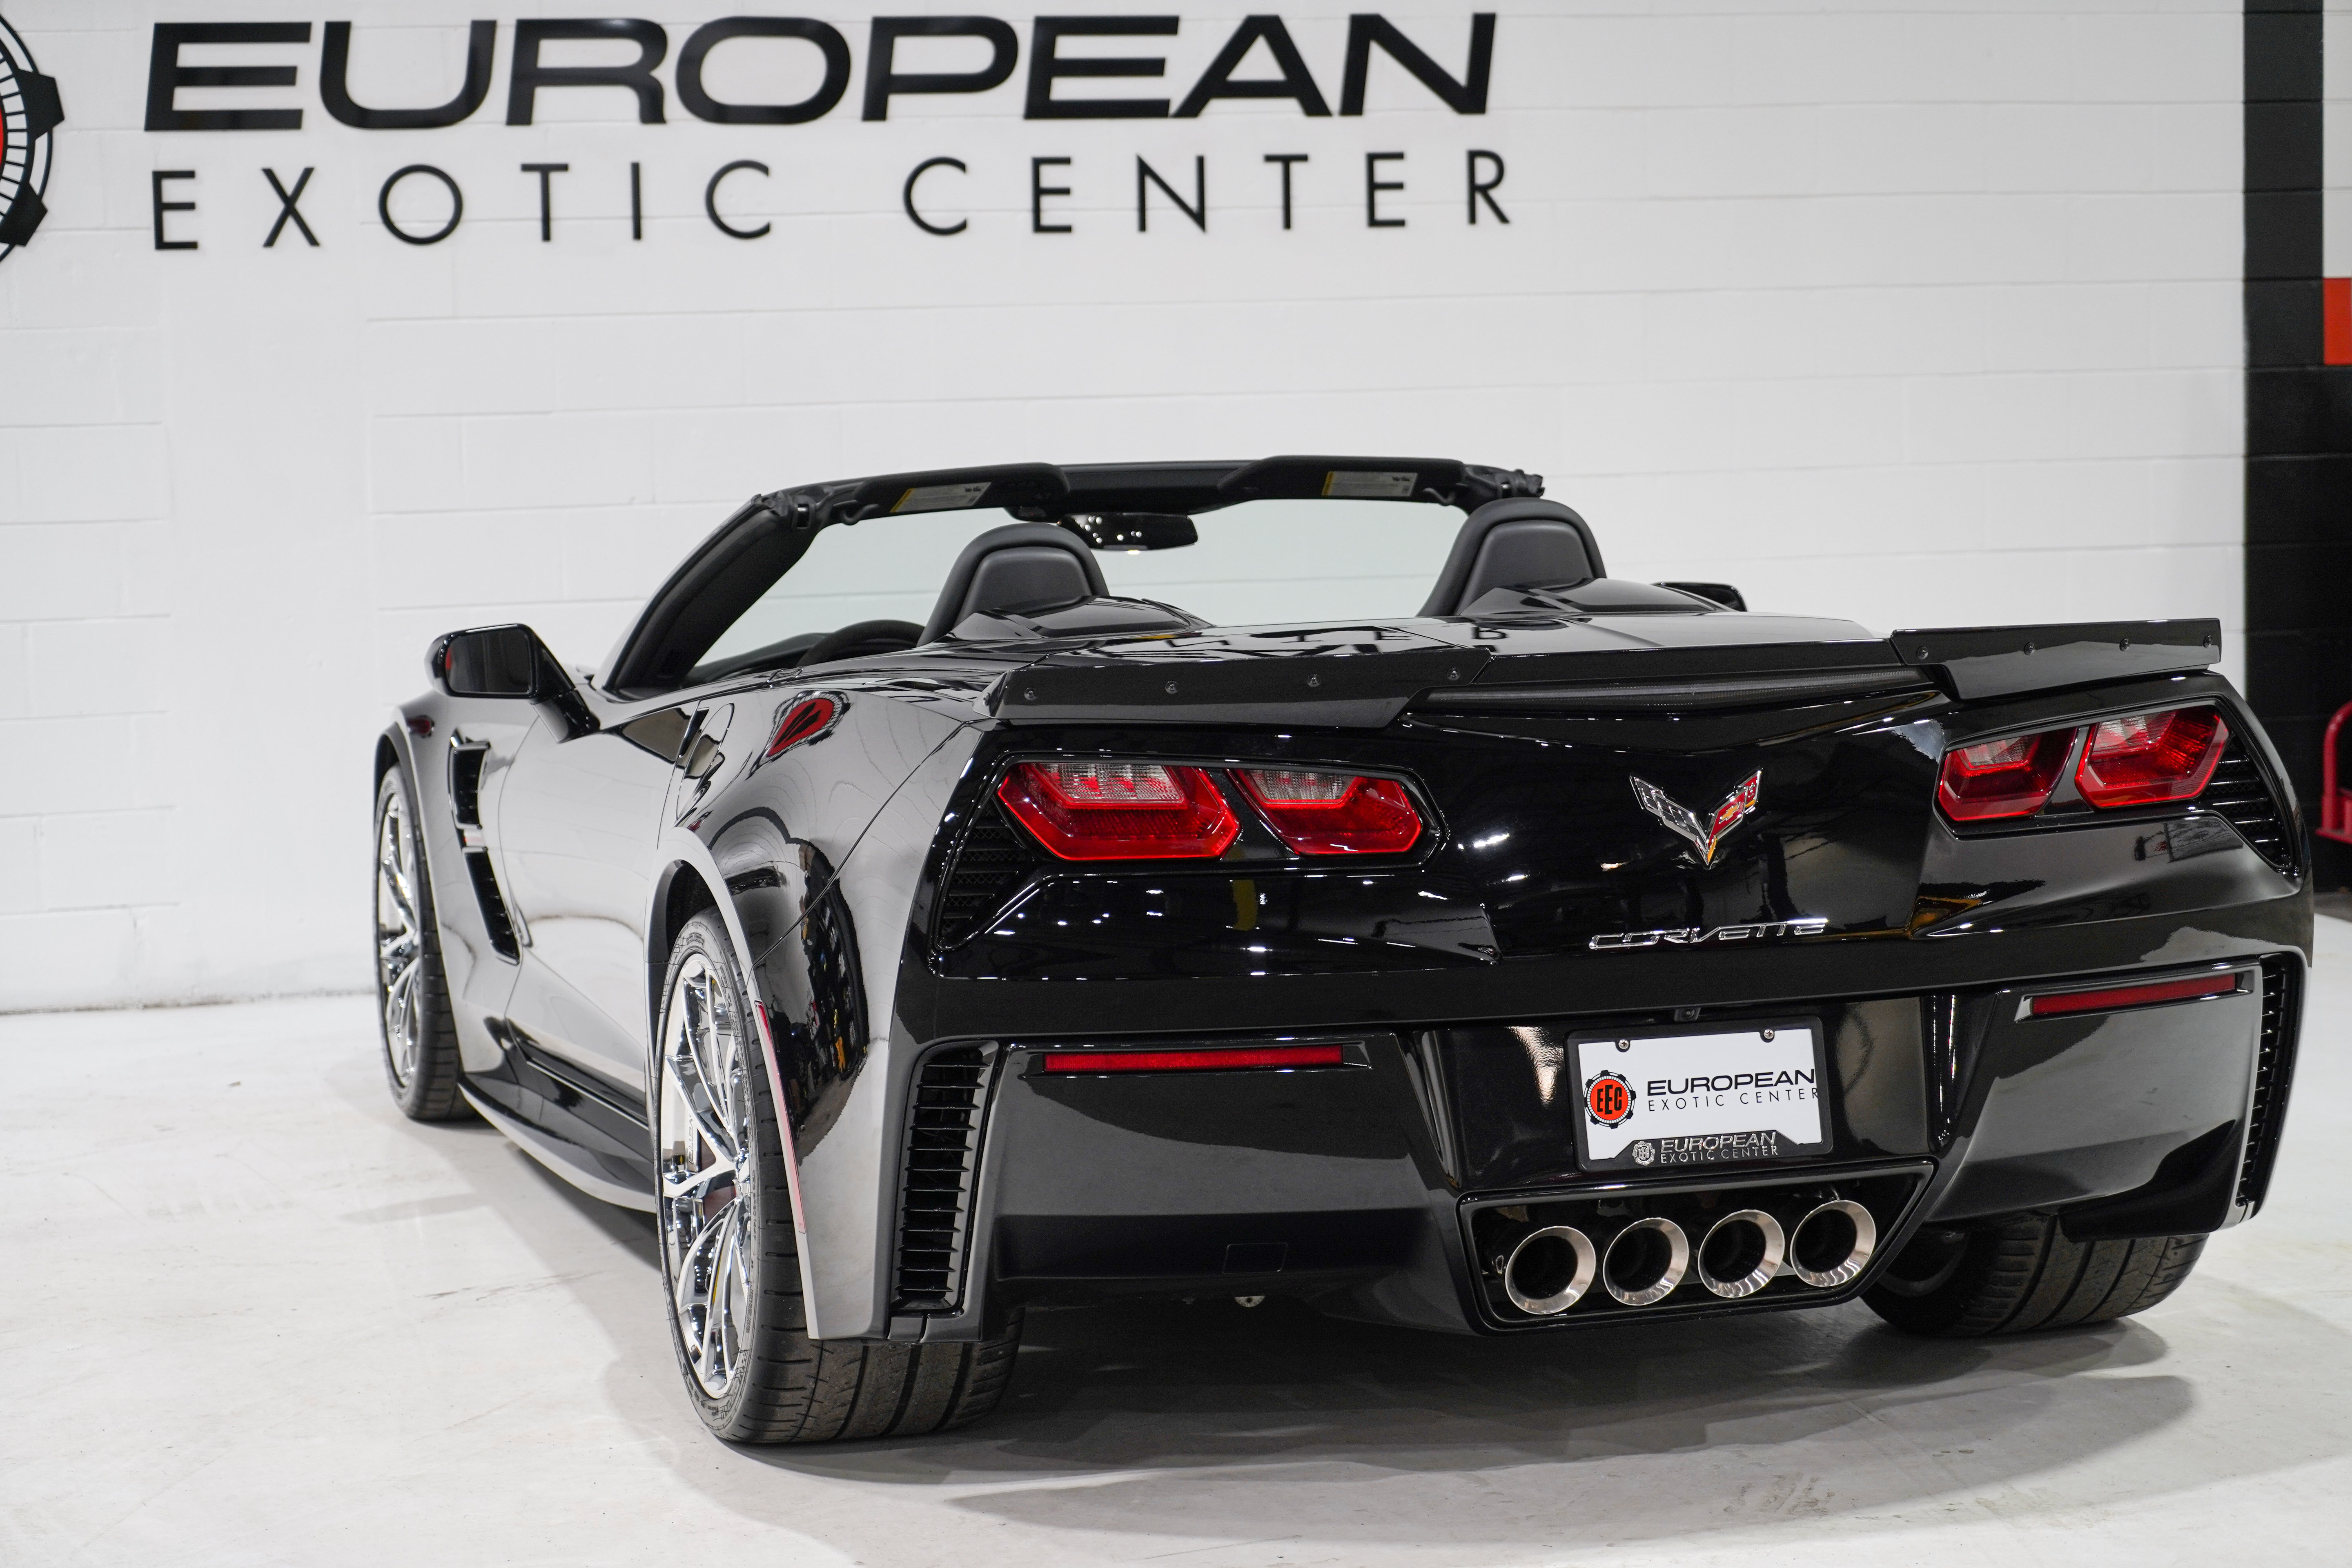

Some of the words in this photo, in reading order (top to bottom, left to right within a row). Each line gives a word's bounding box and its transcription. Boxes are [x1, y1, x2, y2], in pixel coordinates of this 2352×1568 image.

[144, 12, 1497, 132] EUROPEAN
[152, 162, 771, 251] EXOTIC
[903, 149, 1510, 236] CENTER
[1588, 917, 1829, 950] CORVETTE
[1647, 1068, 1815, 1096] EUROPEAN
[1596, 1084, 1623, 1116] EEC
[1648, 1092, 1724, 1112] EXOTIC
[1740, 1087, 1819, 1105] CENTER
[1660, 1131, 1777, 1153] EUROPEAN
[1660, 1149, 1715, 1164] EXOTIC
[1720, 1145, 1779, 1159] CENTER
